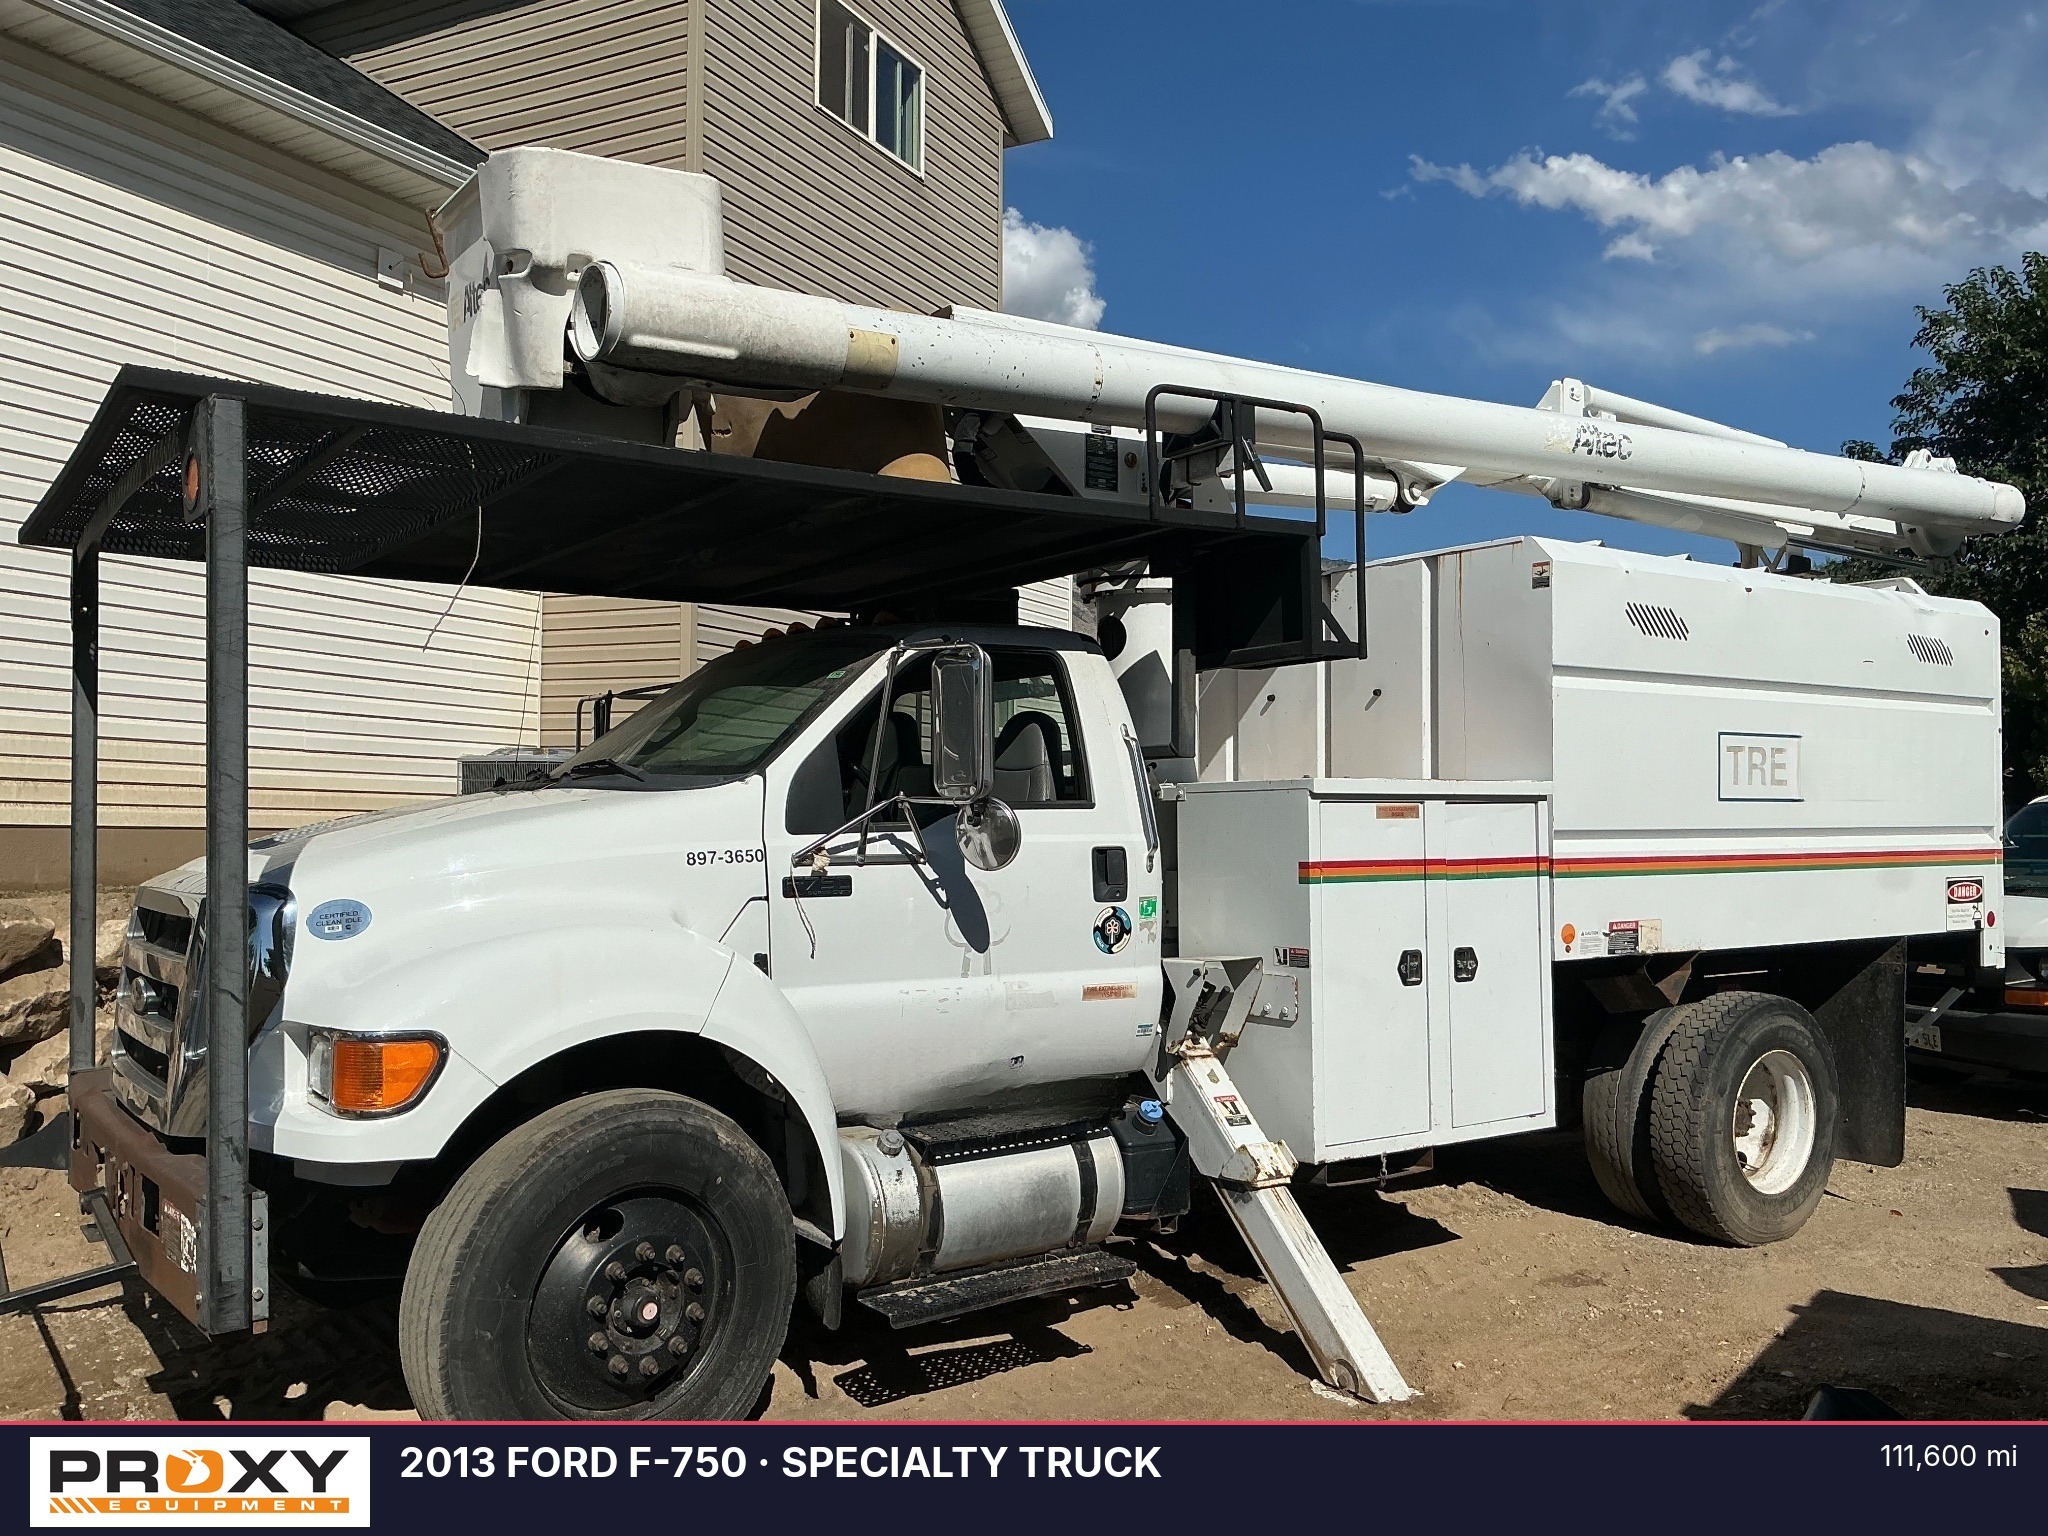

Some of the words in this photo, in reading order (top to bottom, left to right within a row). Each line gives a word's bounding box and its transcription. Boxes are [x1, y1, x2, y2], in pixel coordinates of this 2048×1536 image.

[1725, 745, 1788, 786] TRE
[686, 849, 765, 866] 897-3650
[1953, 886, 1977, 898] DANGER
[315, 919, 342, 927] CLEAN
[345, 916, 362, 924] IDLE
[1617, 922, 1636, 930] DANGER
